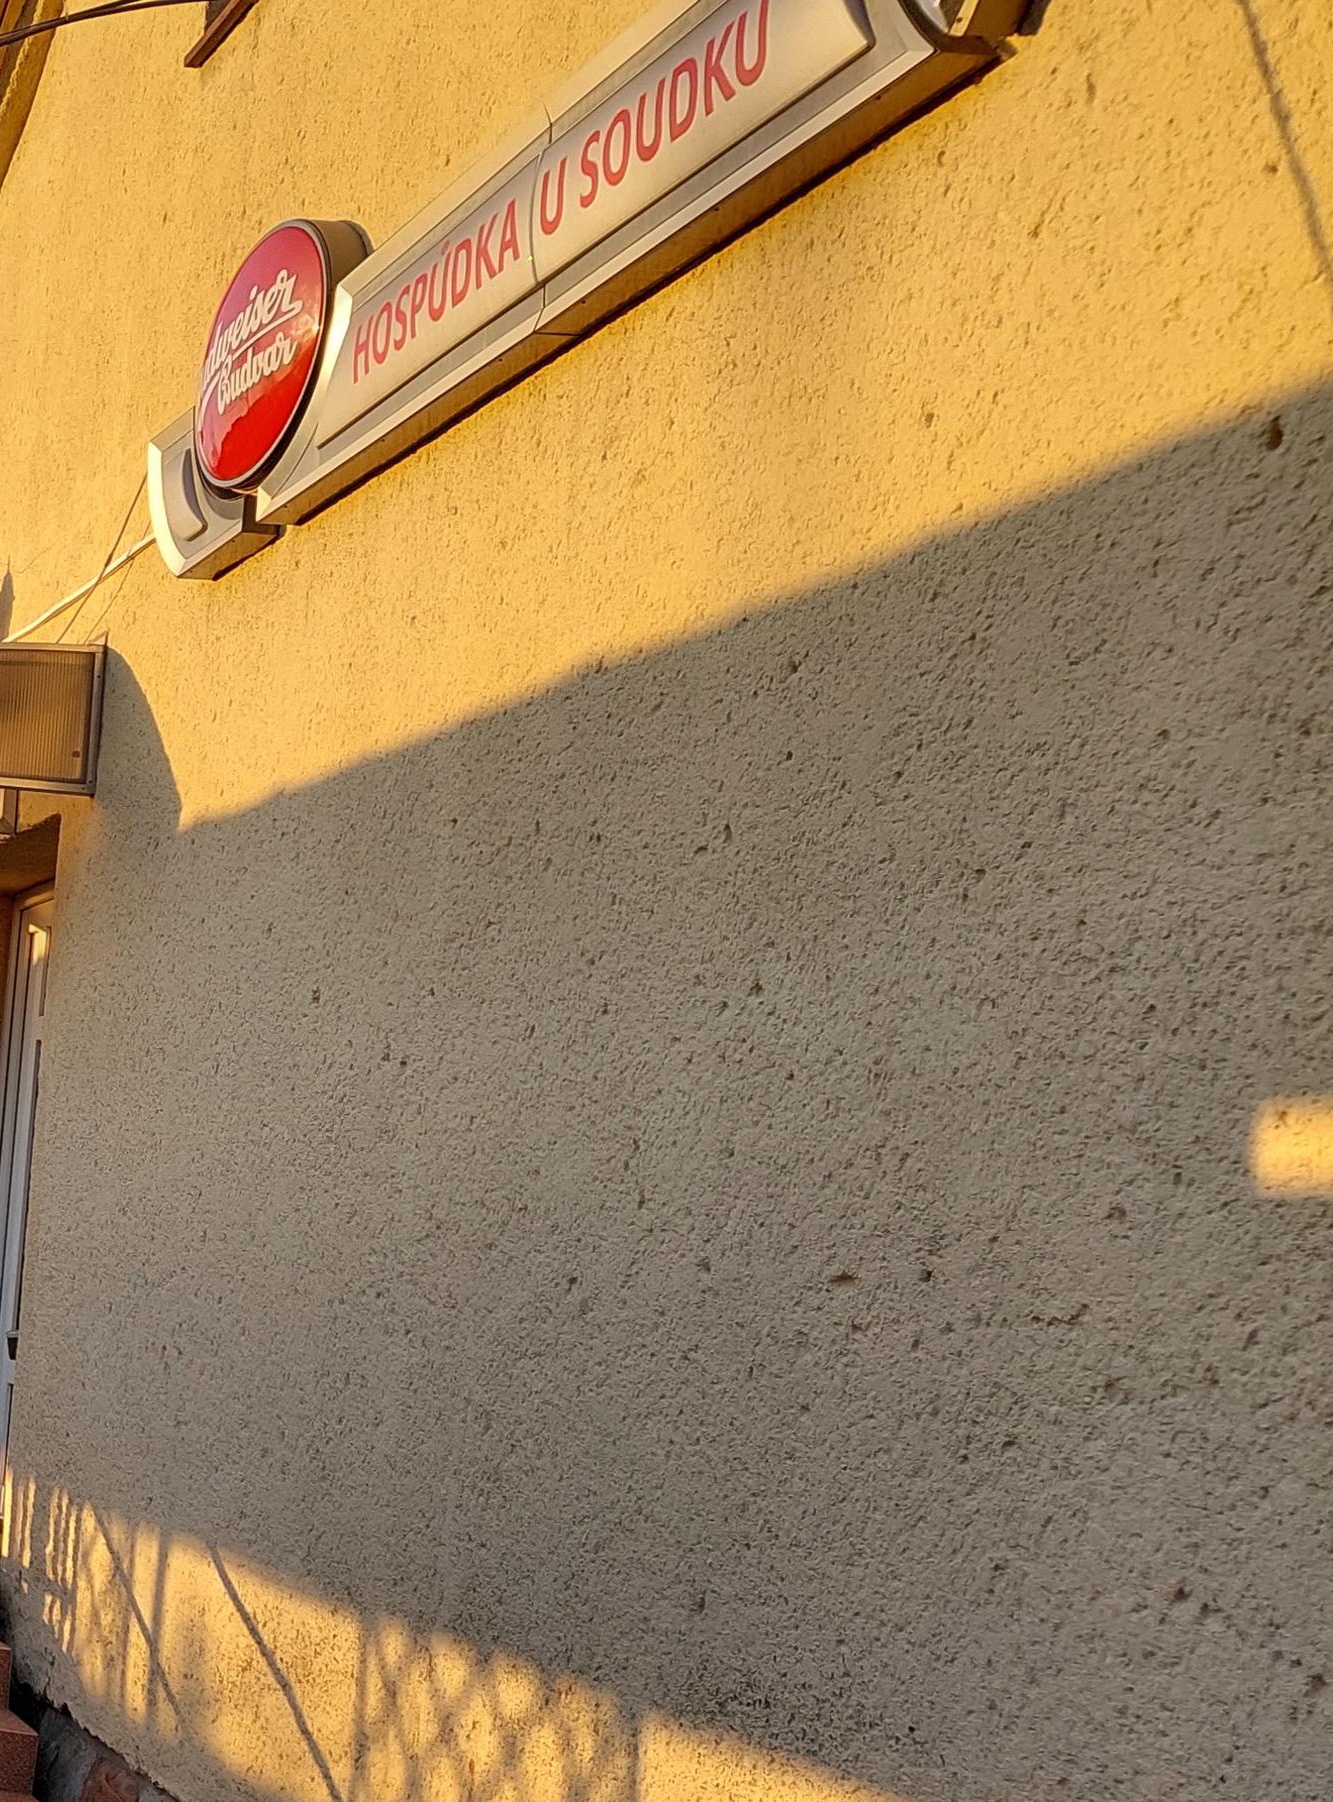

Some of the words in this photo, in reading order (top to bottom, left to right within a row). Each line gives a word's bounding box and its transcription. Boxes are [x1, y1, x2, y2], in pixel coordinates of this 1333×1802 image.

[540, 156, 568, 236] U
[579, 0, 770, 209] SOUDKU
[199, 268, 303, 396] udweiser
[216, 331, 299, 415] Budvar
